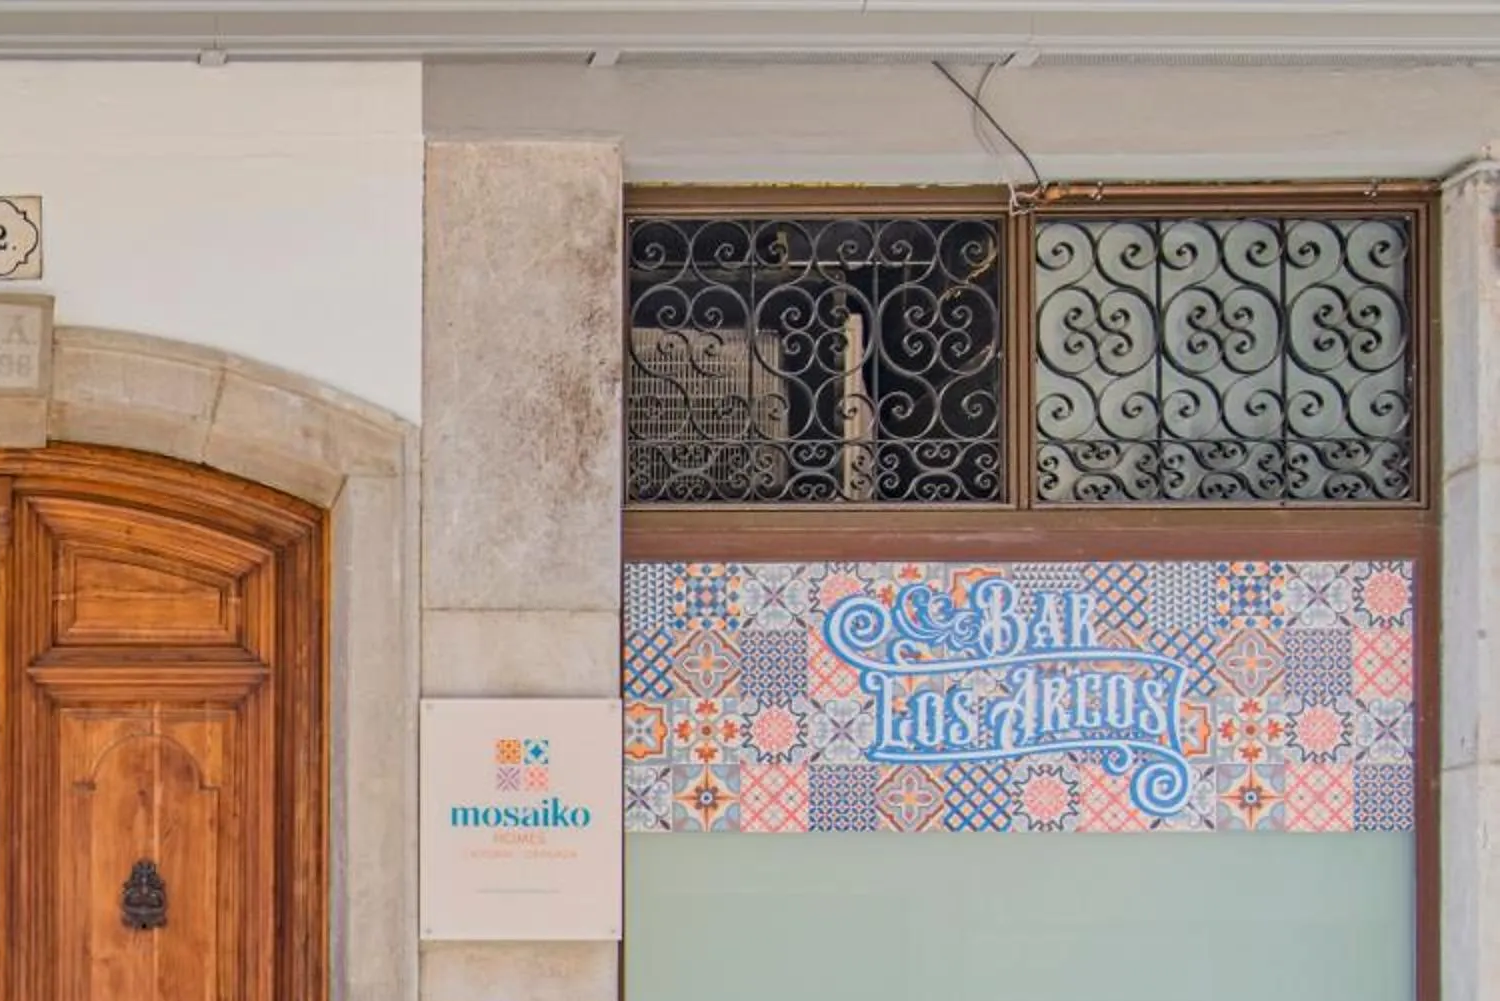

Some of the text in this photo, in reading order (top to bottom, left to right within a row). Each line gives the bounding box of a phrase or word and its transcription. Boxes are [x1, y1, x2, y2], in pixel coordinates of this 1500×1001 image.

[974, 578, 1101, 657] BAR
[862, 666, 1168, 752] LOS ARCOS
[451, 796, 591, 827] mosaiko
